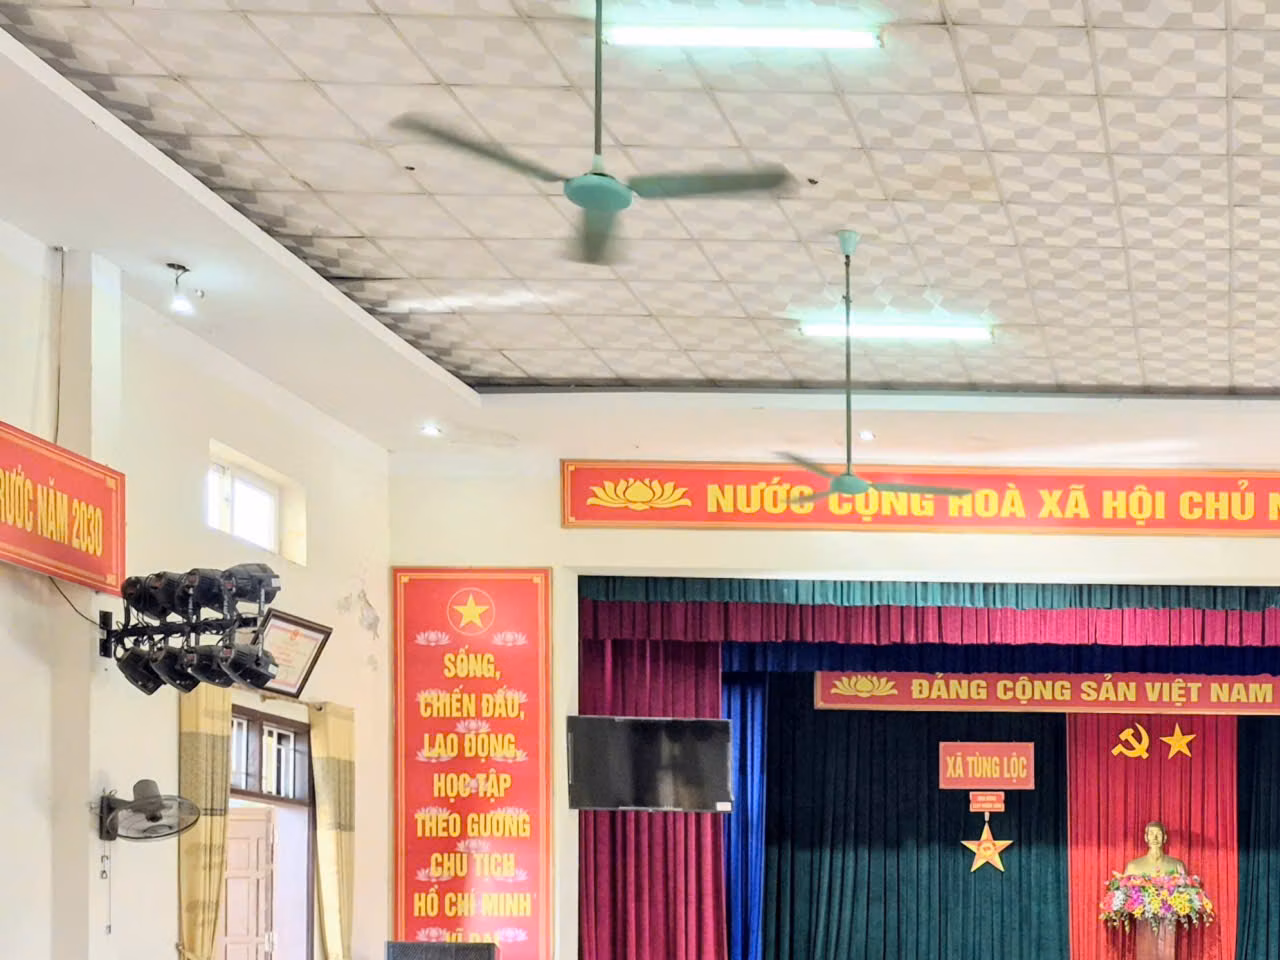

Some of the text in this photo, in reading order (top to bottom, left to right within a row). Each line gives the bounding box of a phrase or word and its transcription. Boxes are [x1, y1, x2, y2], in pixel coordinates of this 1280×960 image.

[37, 477, 69, 544] NĂM
[72, 498, 103, 557] 2030
[707, 480, 814, 514] NƯỚC
[948, 483, 1025, 518] HOÀ
[1039, 484, 1089, 519] XÃ
[1103, 485, 1165, 526] HỘI
[1180, 480, 1254, 521] CHỦ
[443, 645, 501, 680] SỐNG,
[420, 684, 525, 720] CHIẾN ĐẤU,
[911, 672, 988, 700] ĐẢNG
[996, 676, 1072, 704] CỘNG
[1080, 673, 1137, 701] SẢN
[1145, 678, 1202, 706] VIỆT
[1210, 682, 1273, 703] NAM
[424, 732, 459, 758] LAO
[946, 751, 1028, 783] XÃ TÙNG LỘC
[433, 768, 512, 803] HỌC TẬP
[415, 812, 461, 837] THEO
[444, 888, 475, 917] CHÍ
[482, 892, 531, 917] MINH
